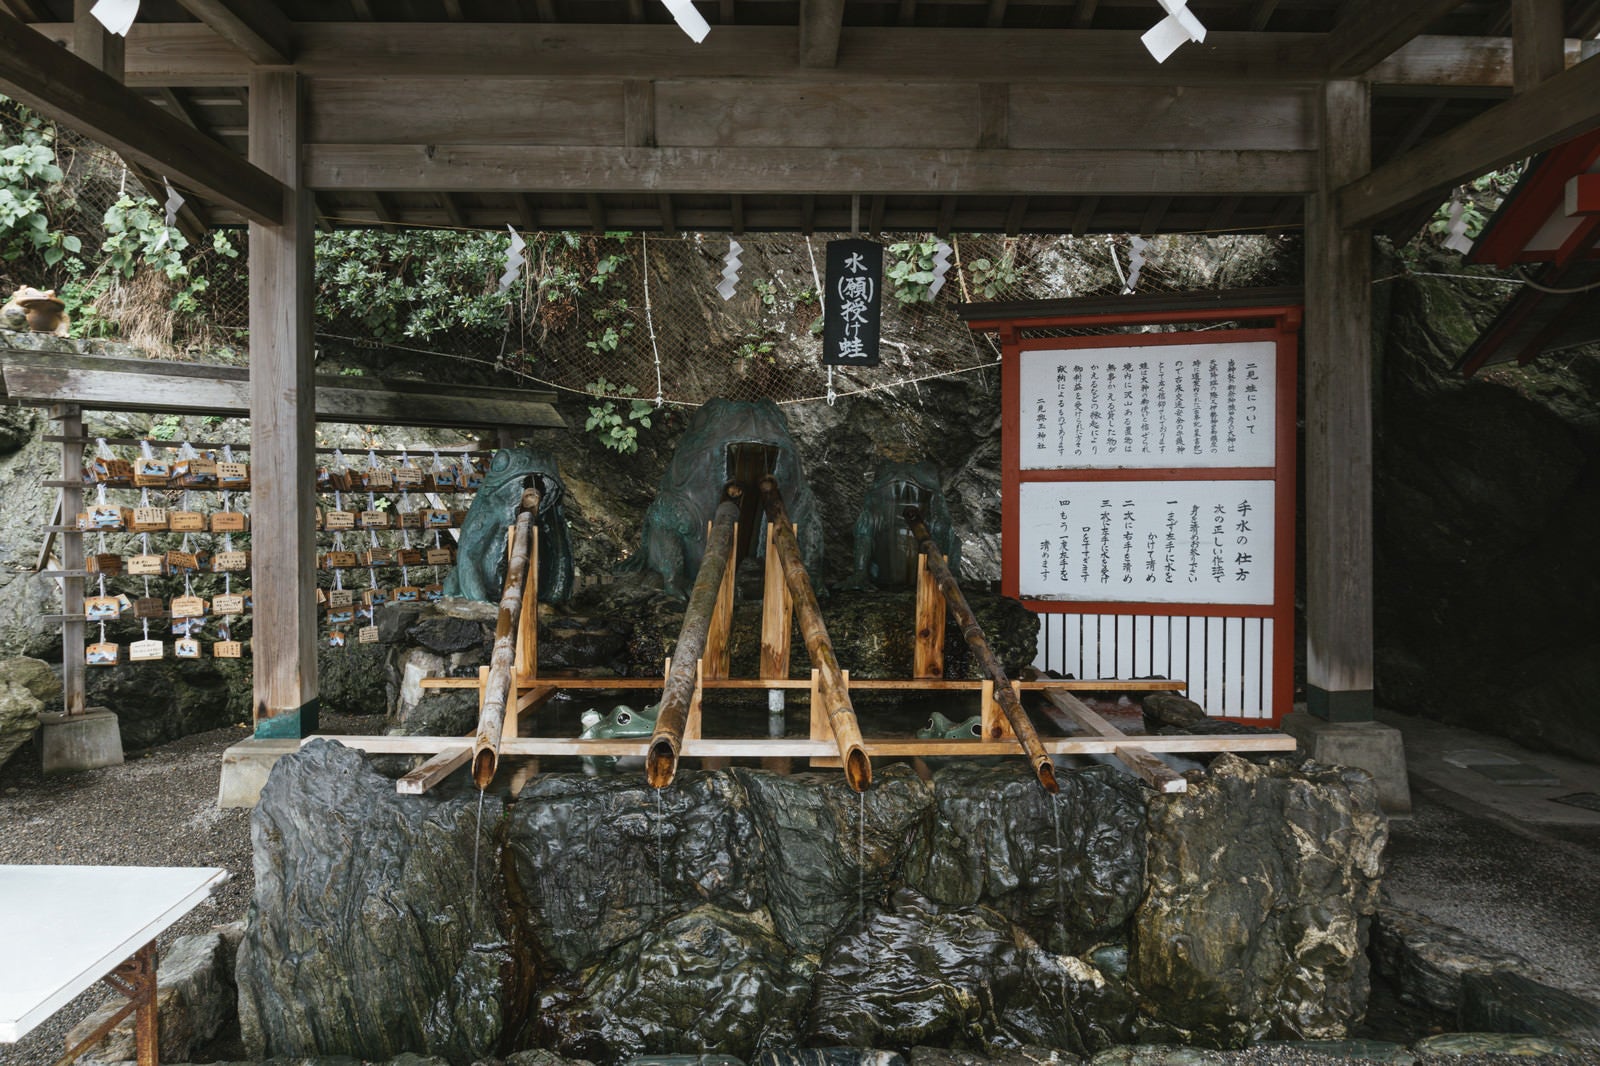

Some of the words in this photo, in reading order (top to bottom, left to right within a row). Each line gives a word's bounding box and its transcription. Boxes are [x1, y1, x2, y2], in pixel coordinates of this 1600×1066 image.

[1035, 397, 1048, 450] 二見興玉神社
[1121, 361, 1135, 453] 境内に沢山ある置物は
[1244, 362, 1260, 435] 二見蛙について
[1039, 538, 1052, 582] 清めます
[1145, 531, 1159, 584] かけて清め
[1210, 503, 1227, 584] 次の正しい作法で
[1234, 499, 1253, 582] 手水の仕方
